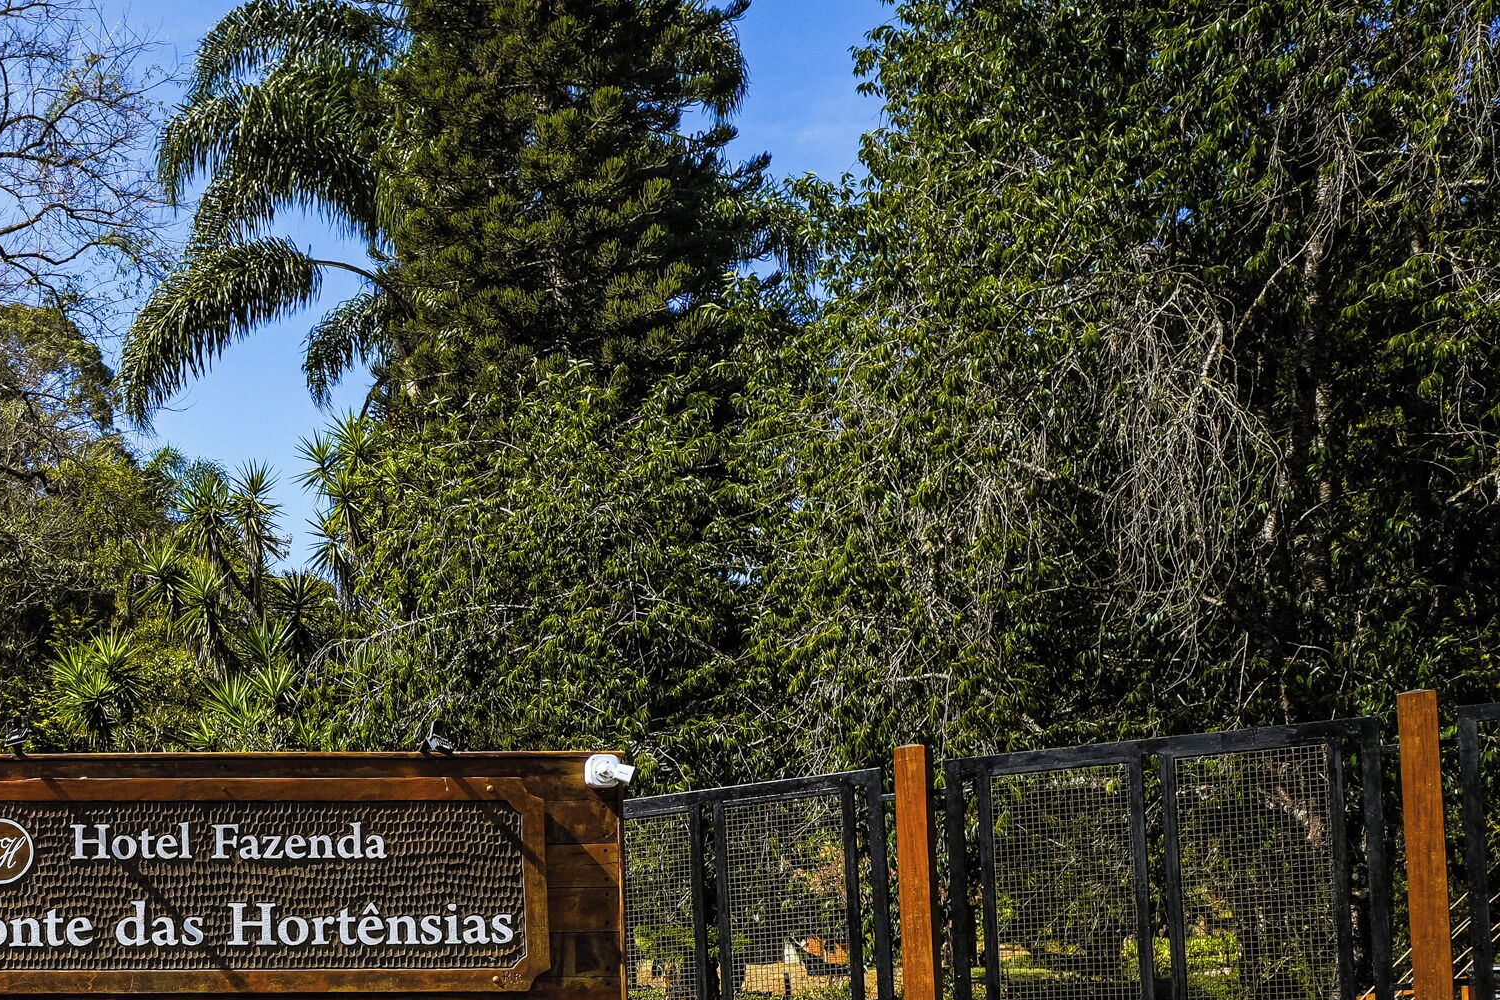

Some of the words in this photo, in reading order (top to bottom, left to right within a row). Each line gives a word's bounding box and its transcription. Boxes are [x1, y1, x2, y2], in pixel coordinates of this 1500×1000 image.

[70, 822, 192, 860] Hotel
[211, 822, 387, 860] Fazenda
[115, 901, 204, 947] das
[227, 902, 514, 946] Hortênsias
